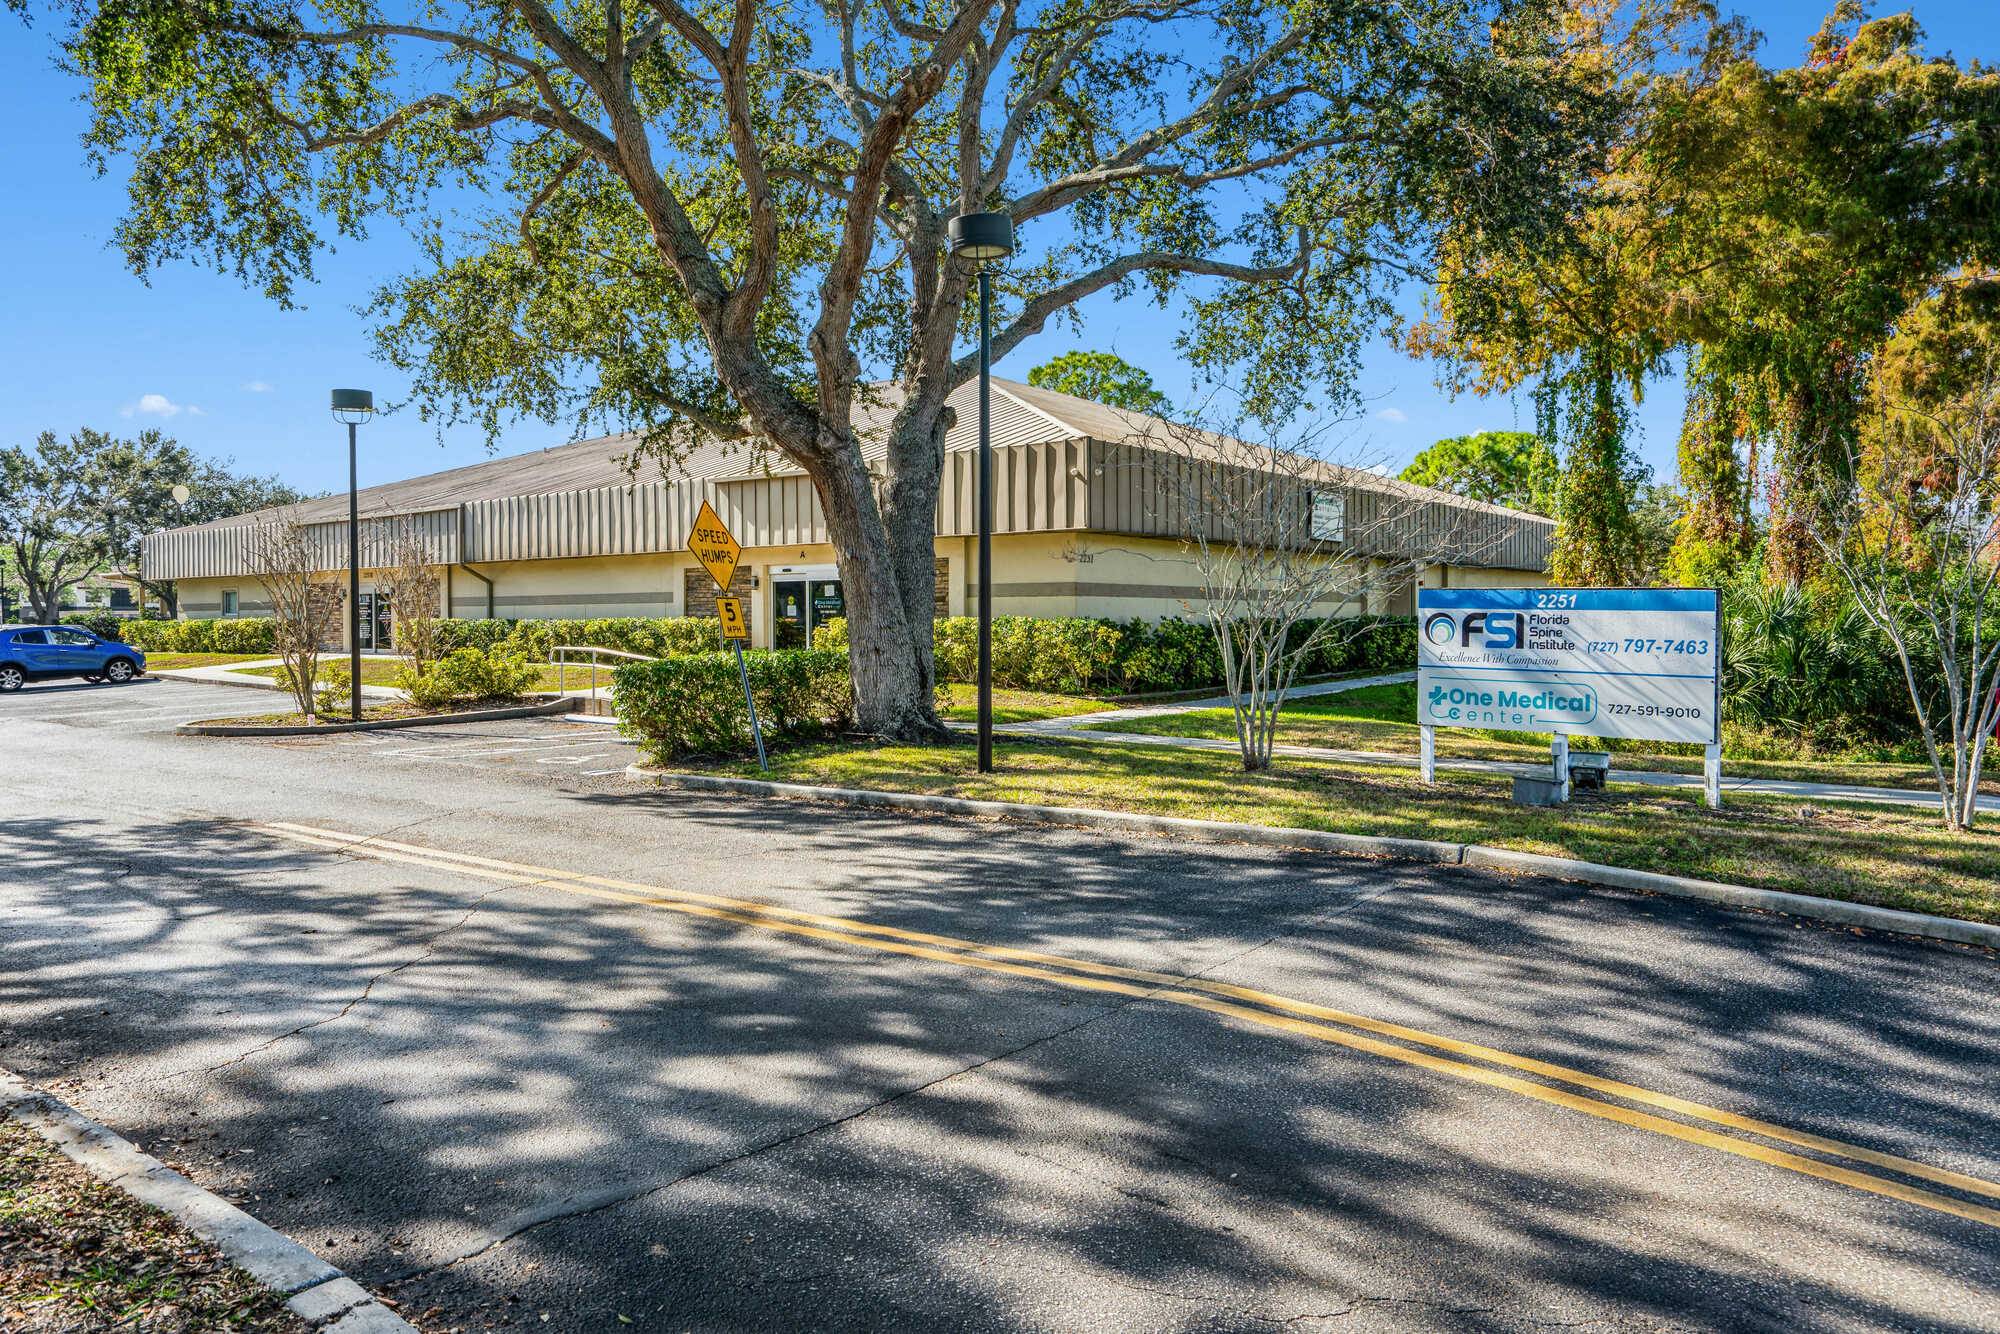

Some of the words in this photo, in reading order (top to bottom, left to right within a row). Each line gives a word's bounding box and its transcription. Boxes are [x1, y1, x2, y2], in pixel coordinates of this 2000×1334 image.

[697, 528, 729, 545] SPEED
[701, 548, 734, 564] HUMPS
[799, 550, 806, 559] A
[1537, 594, 1577, 609] 2251
[724, 602, 736, 621] 5
[1529, 614, 1570, 626] Florida
[727, 625, 741, 633] MPH
[1461, 612, 1525, 650] FSI
[1529, 627, 1563, 640] Spine
[1529, 640, 1576, 651] Institute
[1587, 641, 1619, 655] (727)
[1623, 639, 1709, 655] 797-7463
[1438, 651, 1481, 663] Excellence
[1482, 654, 1506, 664] With
[1506, 654, 1559, 668] Compassion
[1449, 688, 1493, 706] One
[1498, 690, 1591, 712] Medical
[1448, 707, 1536, 725] Center
[1607, 704, 1701, 719] 727-591-9010
